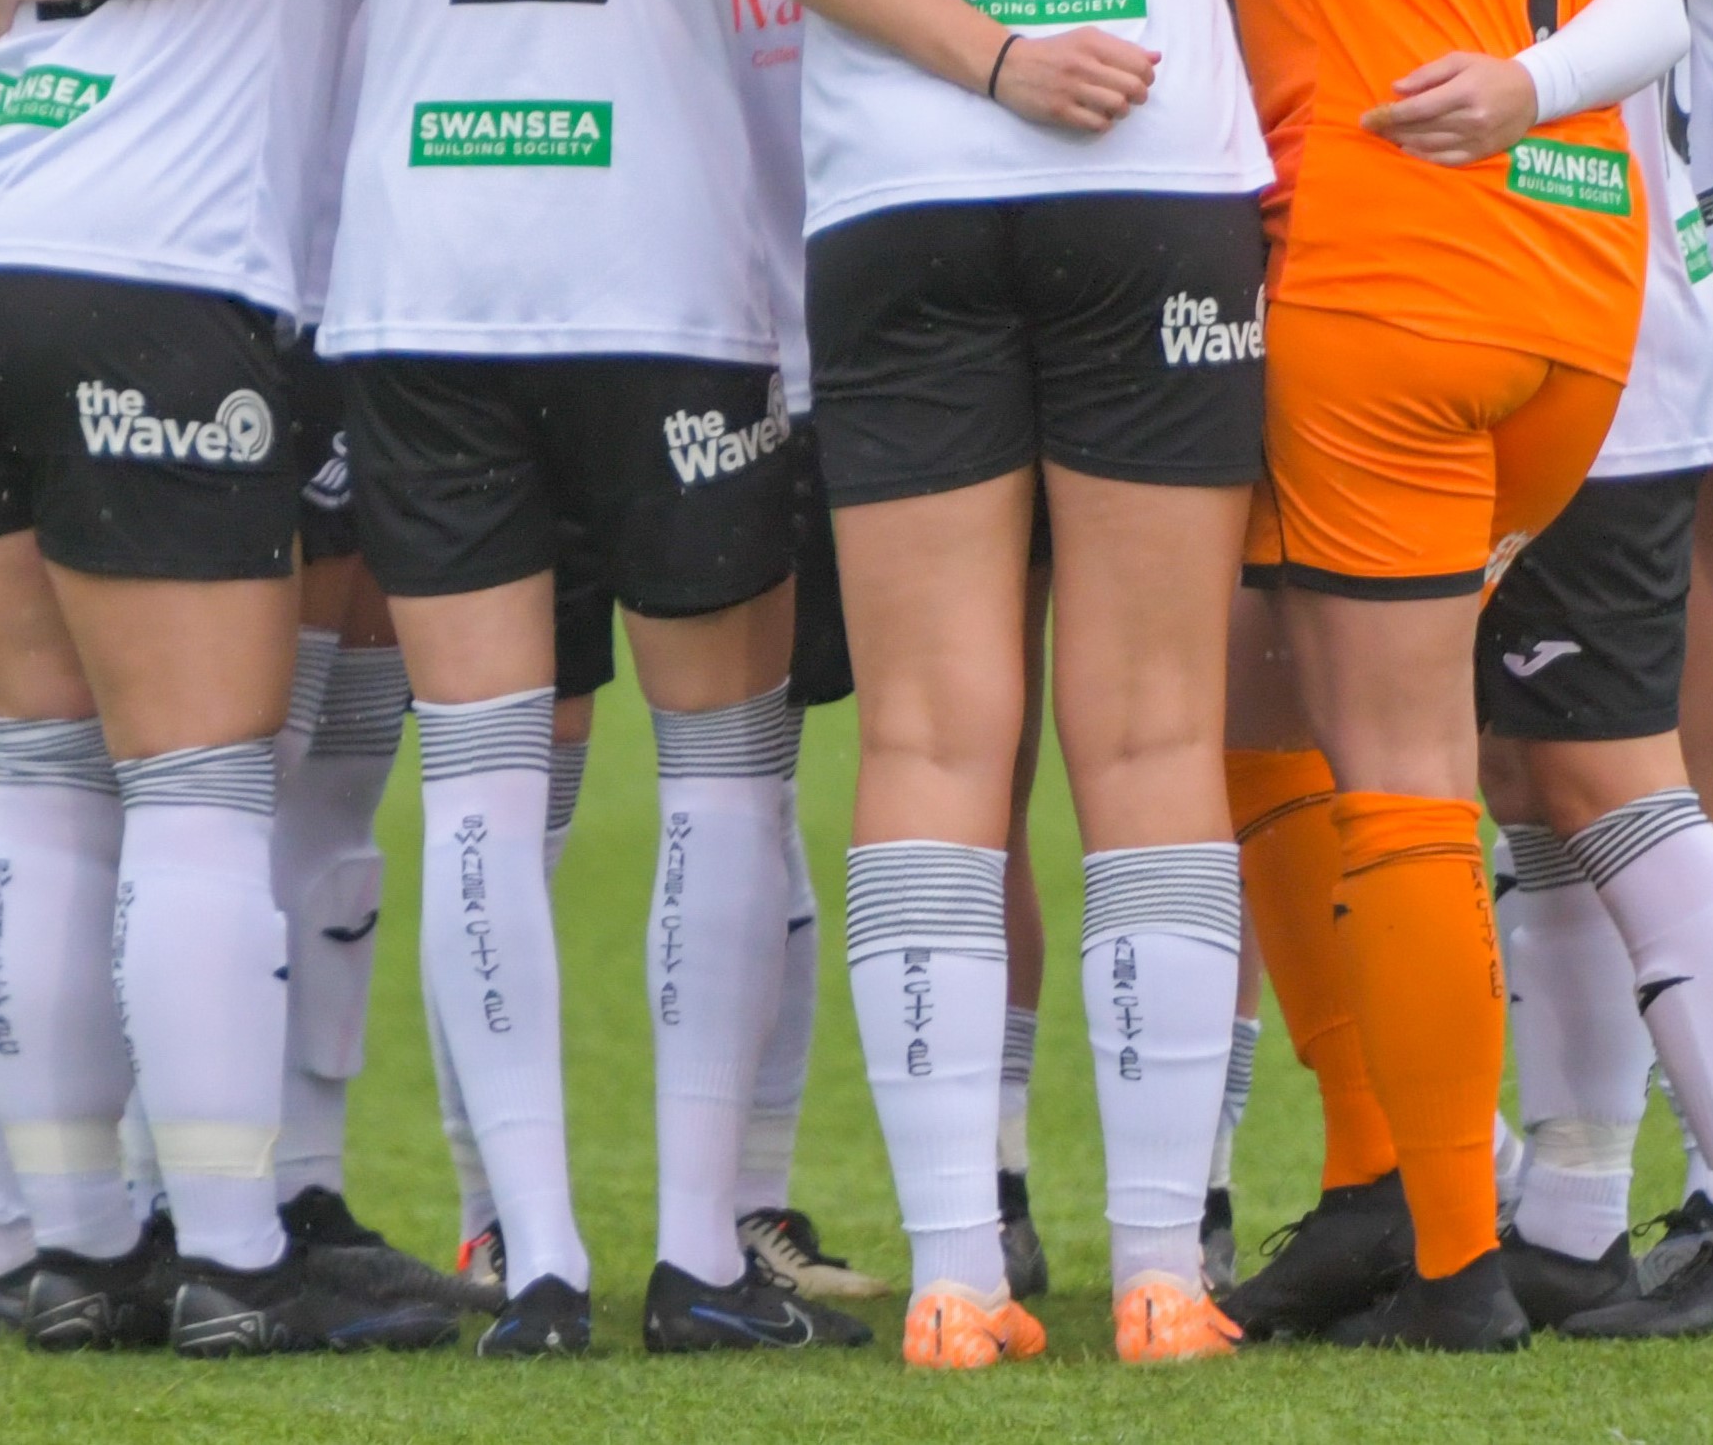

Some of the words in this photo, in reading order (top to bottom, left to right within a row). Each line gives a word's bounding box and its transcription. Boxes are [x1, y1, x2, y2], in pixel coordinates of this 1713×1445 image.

[977, 2, 1037, 16] LDING
[419, 110, 601, 141] SWANSEA
[422, 140, 506, 156] BUILDING
[512, 139, 594, 156] SOCIETY
[1514, 145, 1624, 190] SWANSEA
[1517, 174, 1574, 198] BUILDING
[1578, 186, 1622, 206] SOCIETY
[1163, 290, 1218, 327] the
[76, 380, 146, 417] the
[663, 408, 726, 448] the
[465, 919, 501, 982] CITY
[660, 915, 684, 974] CITY
[903, 980, 935, 1033] CITY
[1112, 995, 1144, 1041] CITY
